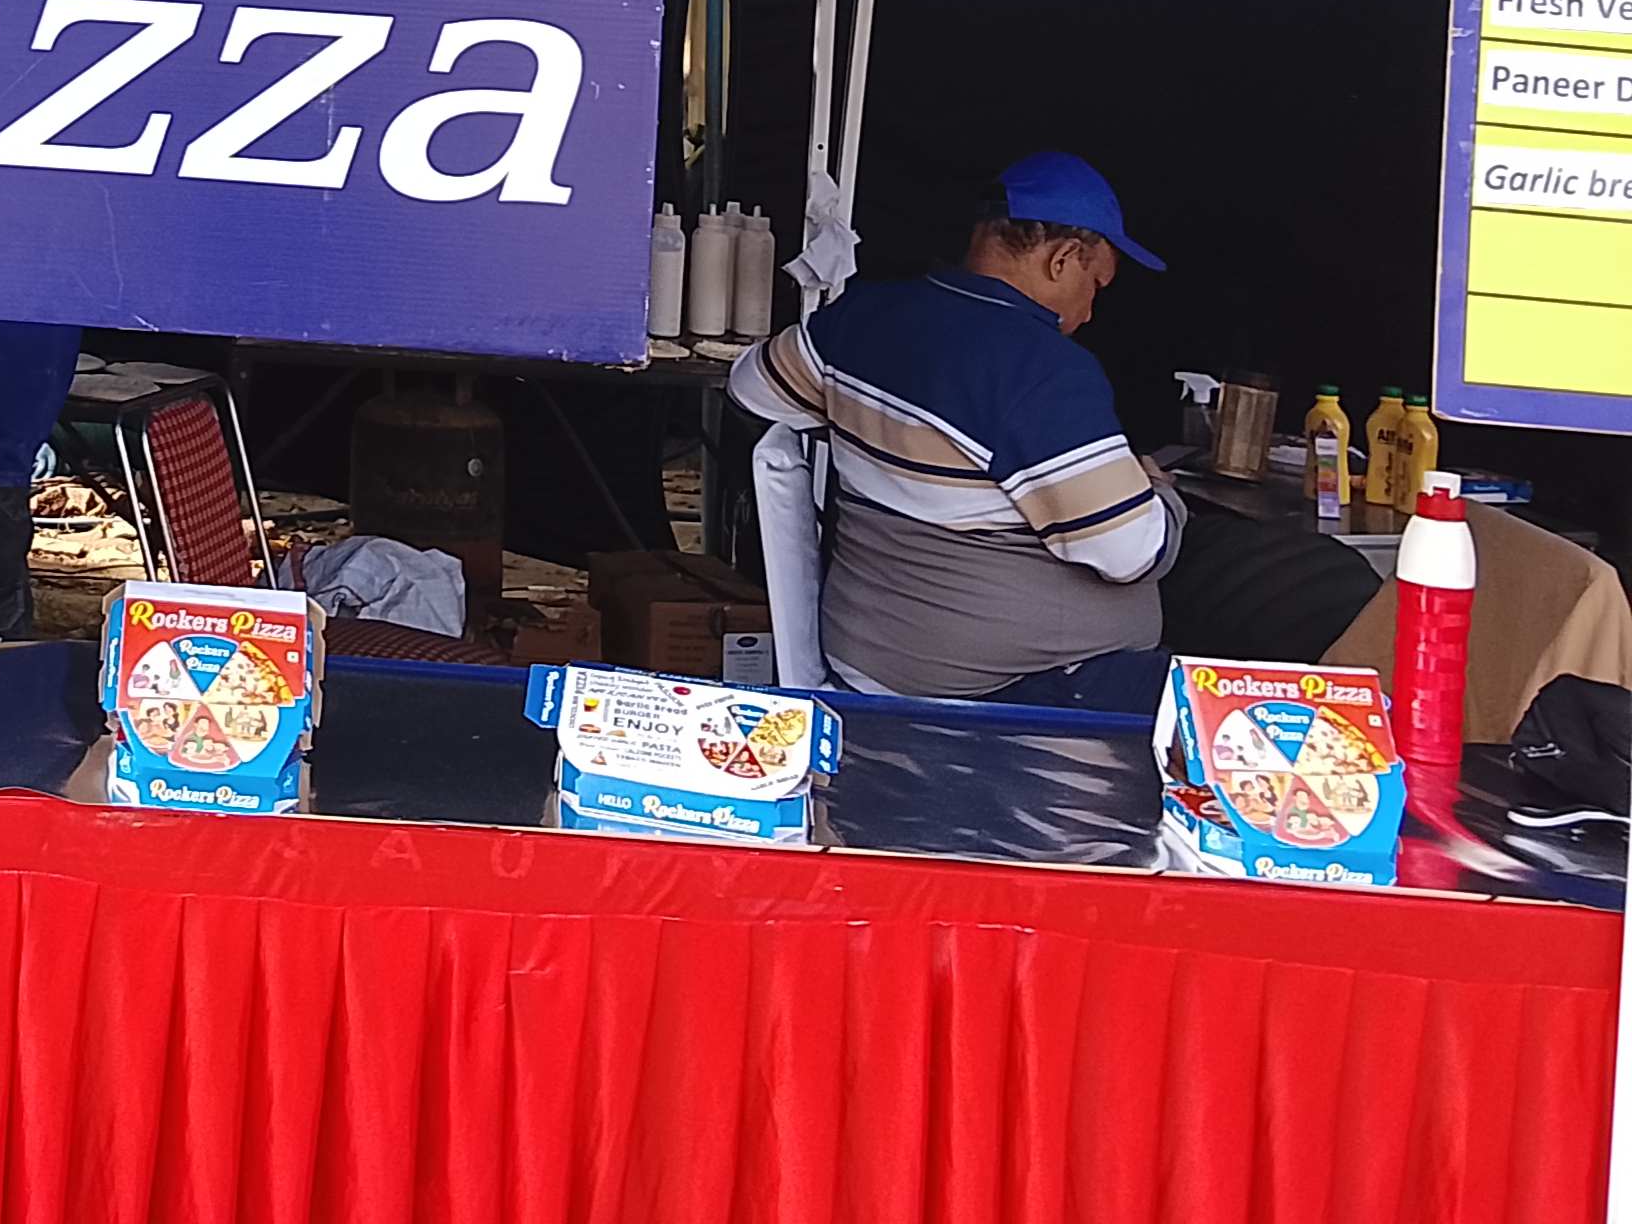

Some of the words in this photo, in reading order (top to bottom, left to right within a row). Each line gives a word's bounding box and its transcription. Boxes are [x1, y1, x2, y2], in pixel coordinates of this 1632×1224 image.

[1491, 65, 1606, 100] Paneer
[1484, 163, 1580, 195] Garlic
[128, 600, 228, 634] Rockers
[230, 611, 297, 642] Pizza
[1191, 666, 1300, 698] Rockers
[1300, 675, 1373, 704] Pizza
[613, 716, 684, 736] ENJOY
[149, 779, 215, 804] Rockers
[215, 785, 260, 809] Pizza
[598, 792, 632, 810] HELLO
[642, 795, 712, 825] Rockers
[1254, 856, 1326, 882] Rockers
